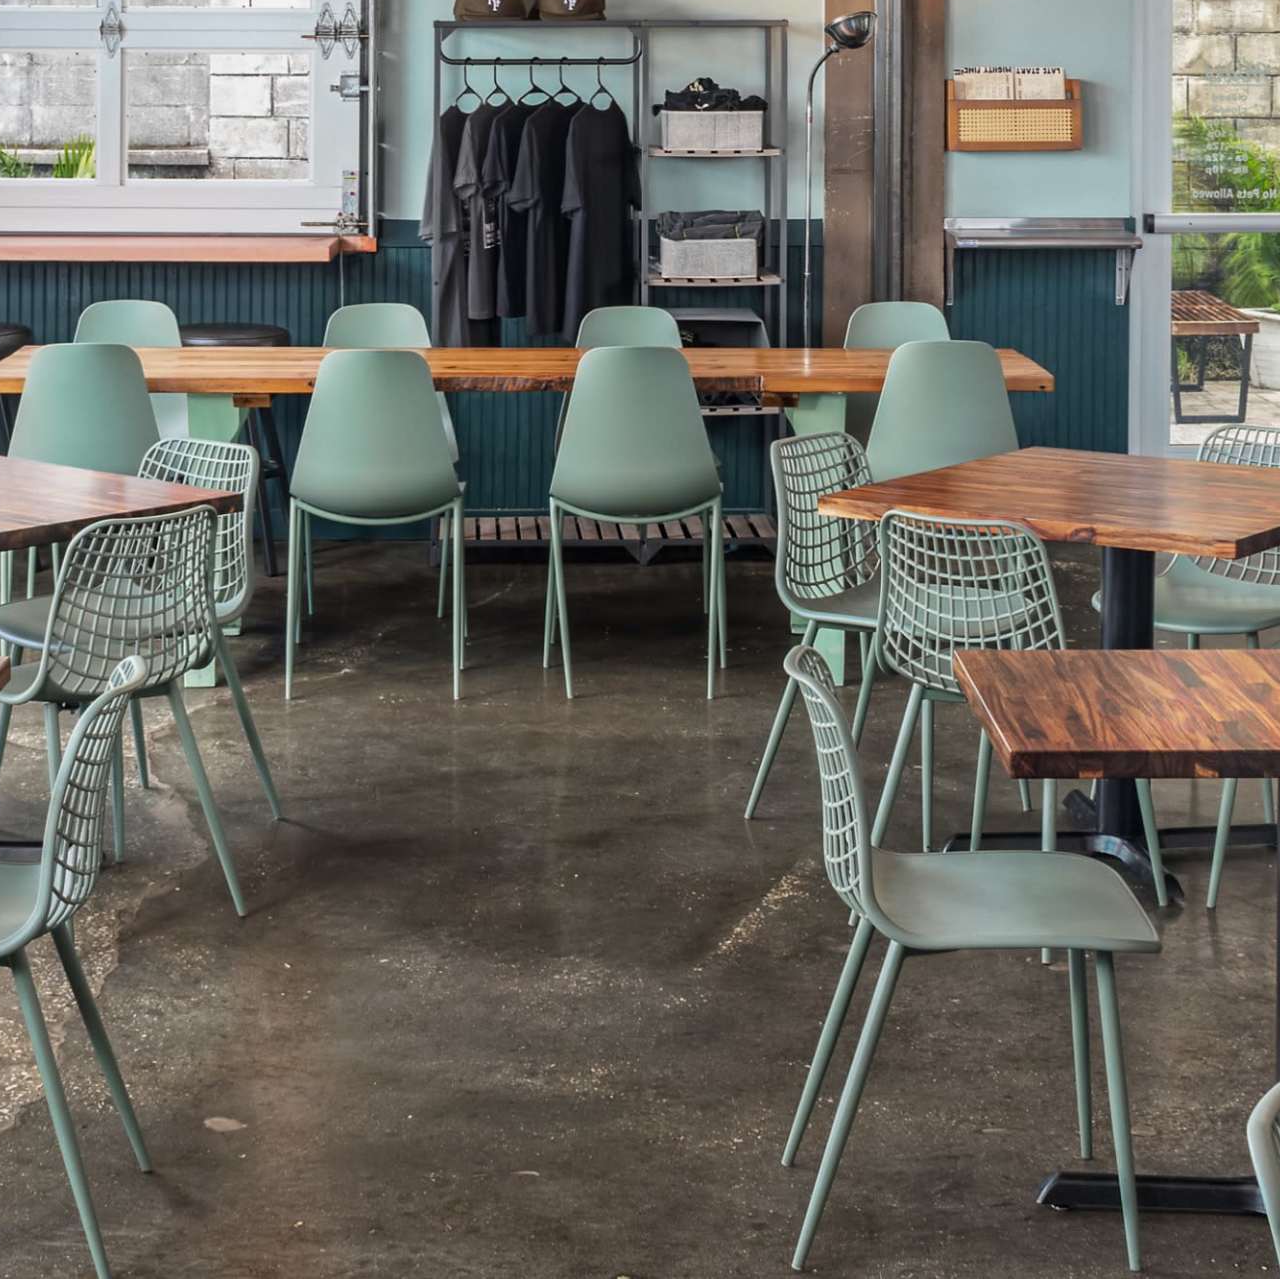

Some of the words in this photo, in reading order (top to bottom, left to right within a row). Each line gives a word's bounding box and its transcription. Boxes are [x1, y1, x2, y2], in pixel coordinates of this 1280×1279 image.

[984, 66, 1013, 74] MIGHTY
[1016, 67, 1040, 75] START
[1042, 67, 1061, 75] LATE
